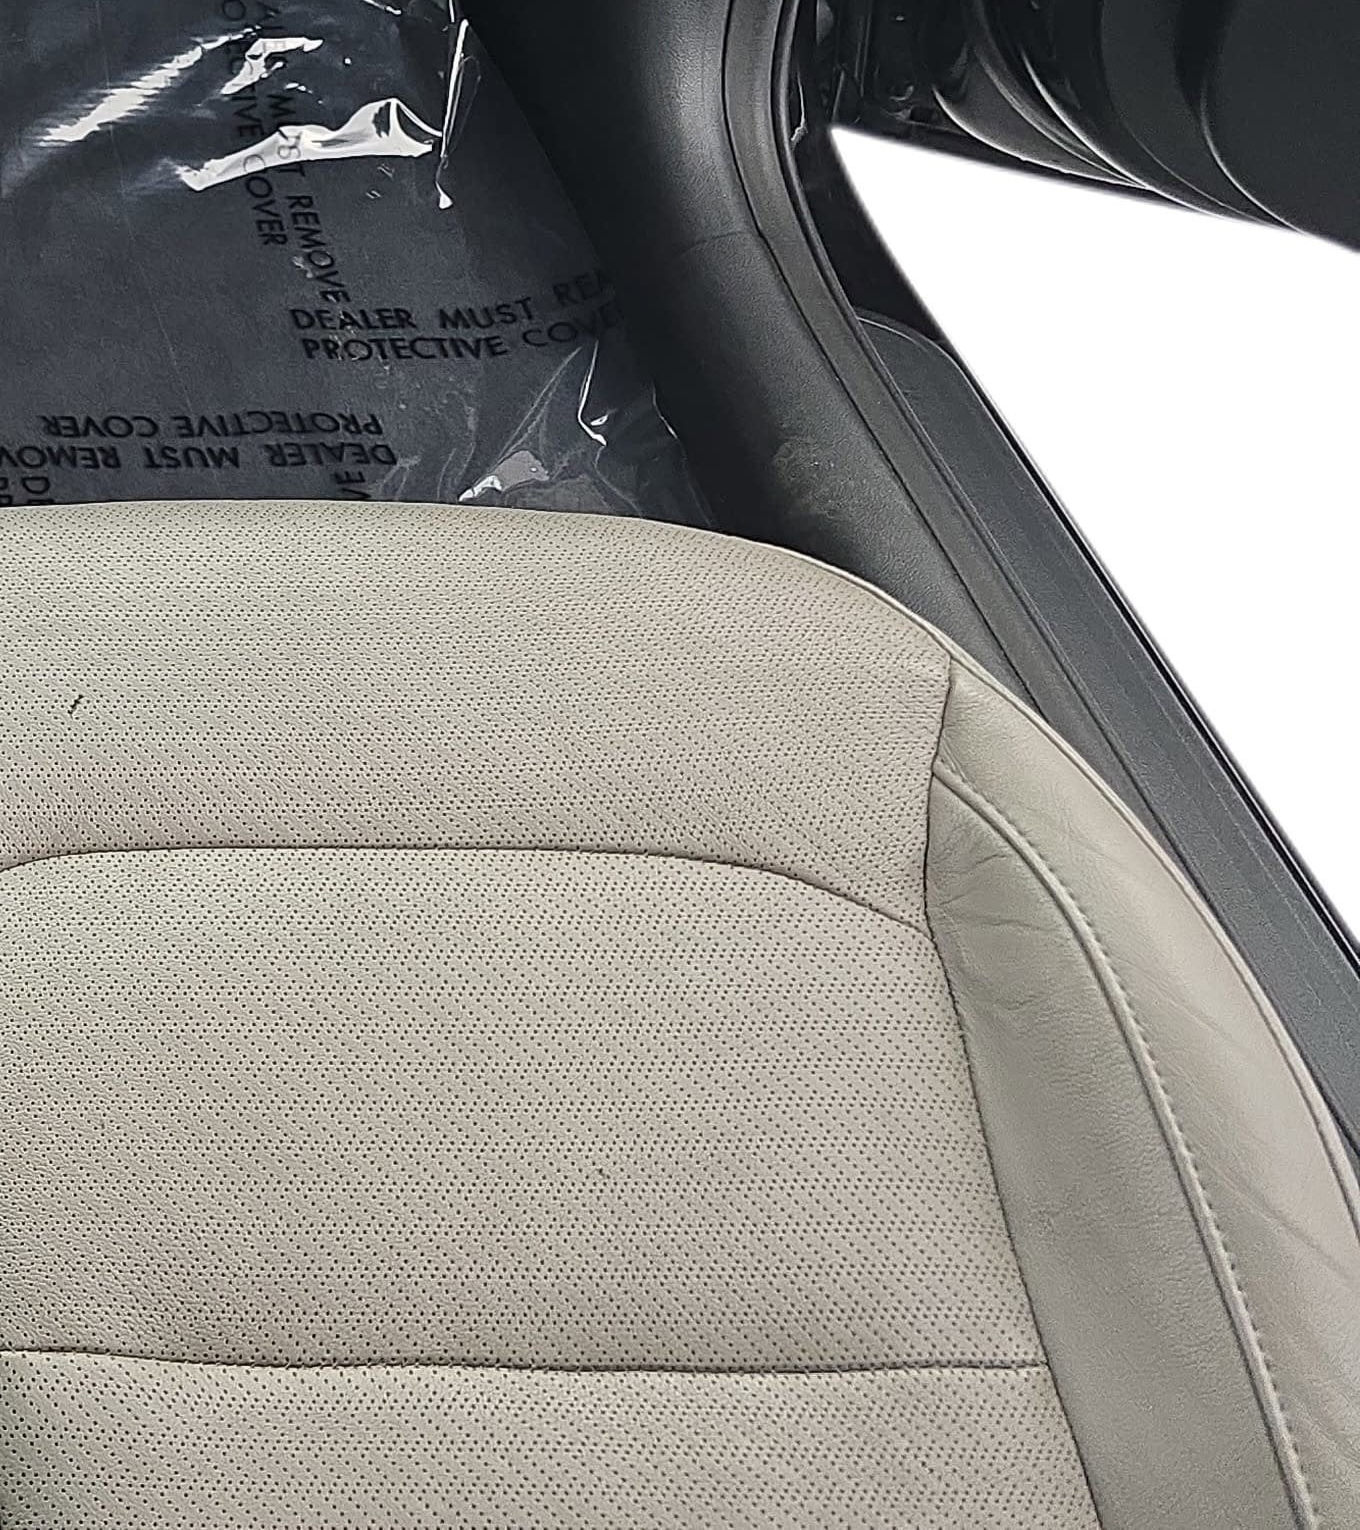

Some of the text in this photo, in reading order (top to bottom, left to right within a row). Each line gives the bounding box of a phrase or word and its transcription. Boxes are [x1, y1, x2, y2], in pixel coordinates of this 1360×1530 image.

[285, 194, 351, 305] REMOVE
[289, 297, 532, 331] DEALER MUST
[303, 335, 509, 361] PROTECTIVE
[38, 411, 384, 440] PROTECTIVE COVER
[141, 445, 241, 470] MUST
[263, 442, 398, 468] DEALER
